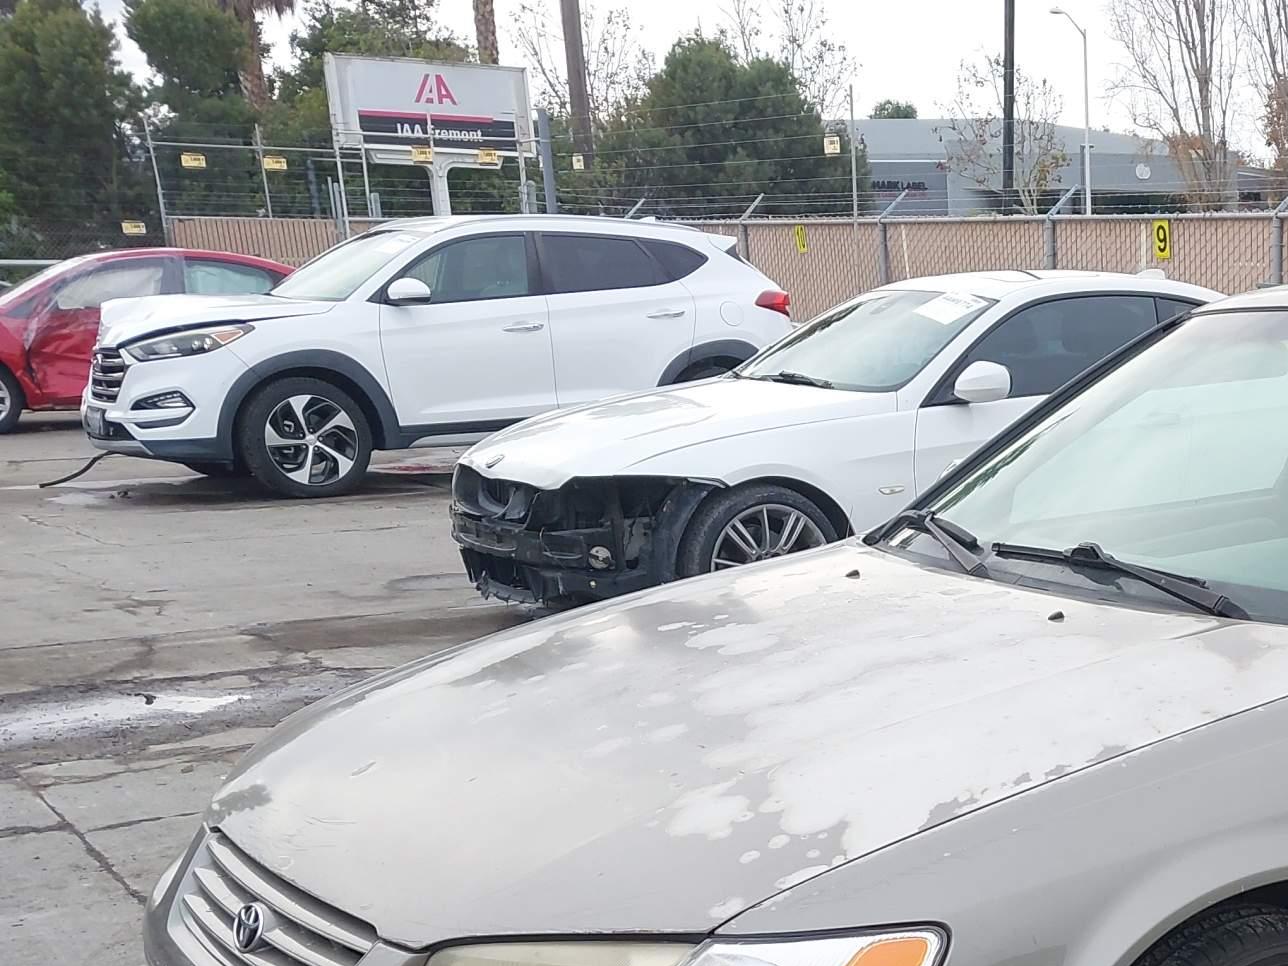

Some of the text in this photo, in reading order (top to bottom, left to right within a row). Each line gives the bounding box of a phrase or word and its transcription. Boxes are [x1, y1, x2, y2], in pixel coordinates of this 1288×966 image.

[397, 122, 484, 142] IAA Fremont
[1156, 224, 1167, 253] 9
